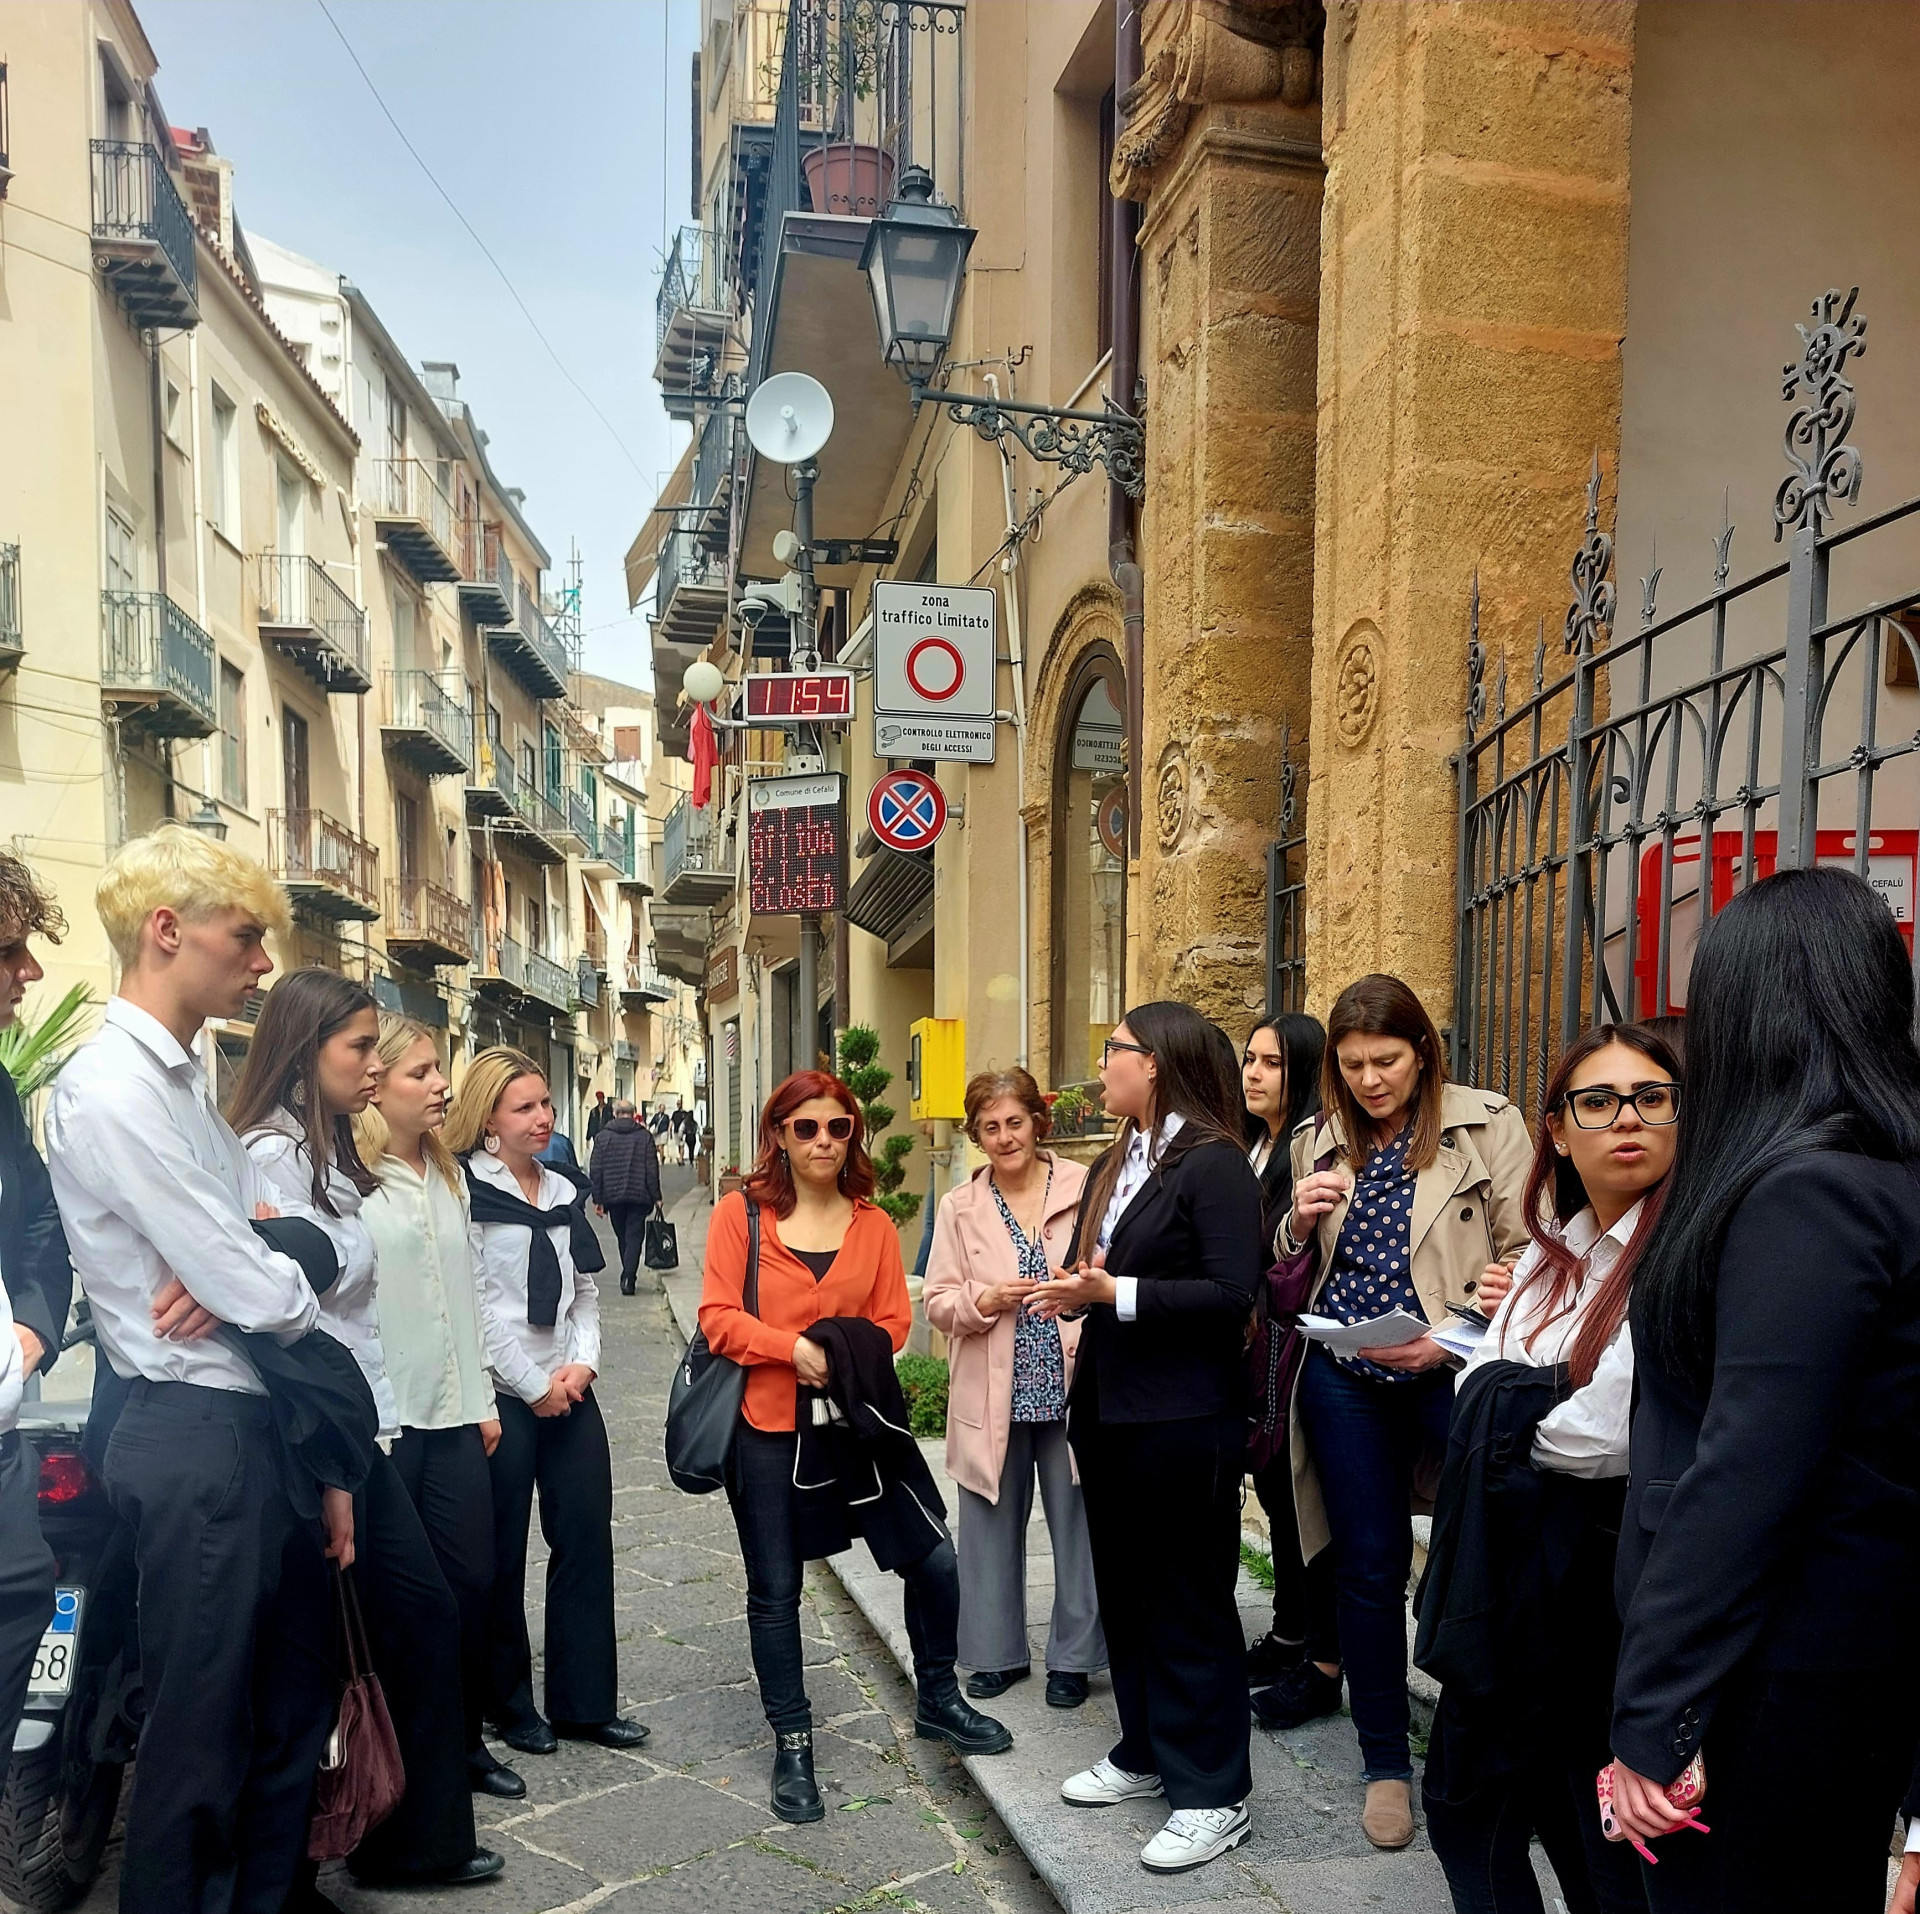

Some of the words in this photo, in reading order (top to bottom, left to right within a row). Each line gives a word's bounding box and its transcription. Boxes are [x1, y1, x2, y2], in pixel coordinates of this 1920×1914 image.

[922, 596, 949, 607] zona
[882, 610, 932, 625] traffico
[938, 611, 989, 628] limitato
[765, 679, 847, 713] 11:54
[902, 728, 943, 738] CONTROLLO
[945, 730, 992, 740] ELETTRONICO
[922, 743, 941, 752] DEGLI
[944, 744, 972, 753] ACCESSI
[776, 789, 803, 798] Comune
[804, 787, 811, 795] di
[813, 785, 835, 794] Cefalù
[752, 883, 834, 911] CLOSED
